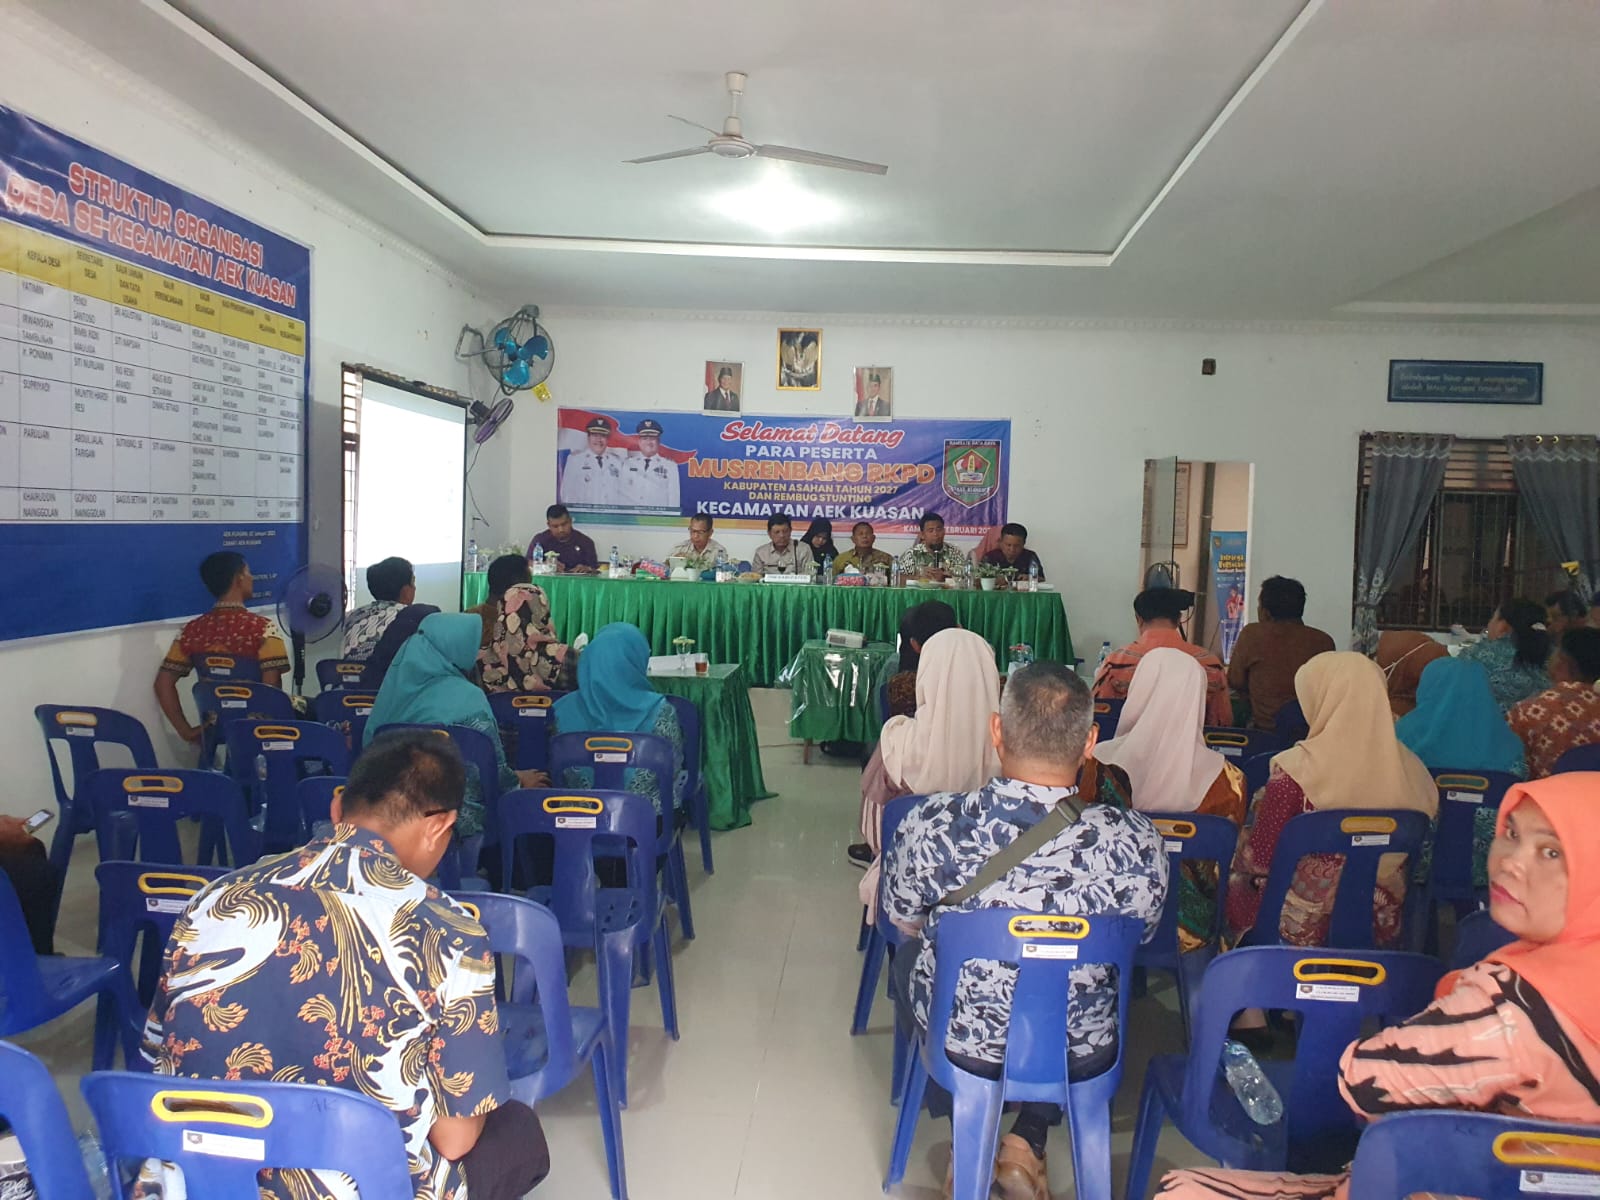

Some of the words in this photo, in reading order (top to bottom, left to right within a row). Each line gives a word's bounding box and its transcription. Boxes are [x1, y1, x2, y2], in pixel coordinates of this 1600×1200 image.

[68, 162, 173, 232] STRUKTUR
[174, 209, 264, 269] ORGANISASI
[5, 175, 70, 226] DESA
[74, 200, 213, 278] SE-KECAMATAN
[215, 261, 243, 290] AEK
[246, 267, 296, 309] KUASAN
[720, 420, 818, 442] Selamat
[820, 422, 906, 449] Datang
[745, 445, 796, 459] PARA
[799, 446, 878, 460] PESERTA
[687, 457, 864, 482] MUSRENBANG
[866, 463, 936, 484] RKPD
[723, 481, 787, 492] KABUPATEN
[788, 483, 834, 493] ASAHAN
[835, 485, 872, 494] TAHUN
[873, 486, 898, 494] 2027
[748, 491, 773, 501] DAN
[774, 492, 818, 502] REMBUG
[819, 493, 873, 504] STUNTING
[697, 501, 809, 519] KECAMATAN
[812, 505, 847, 519] AEK
[850, 506, 925, 519] KUASAN
